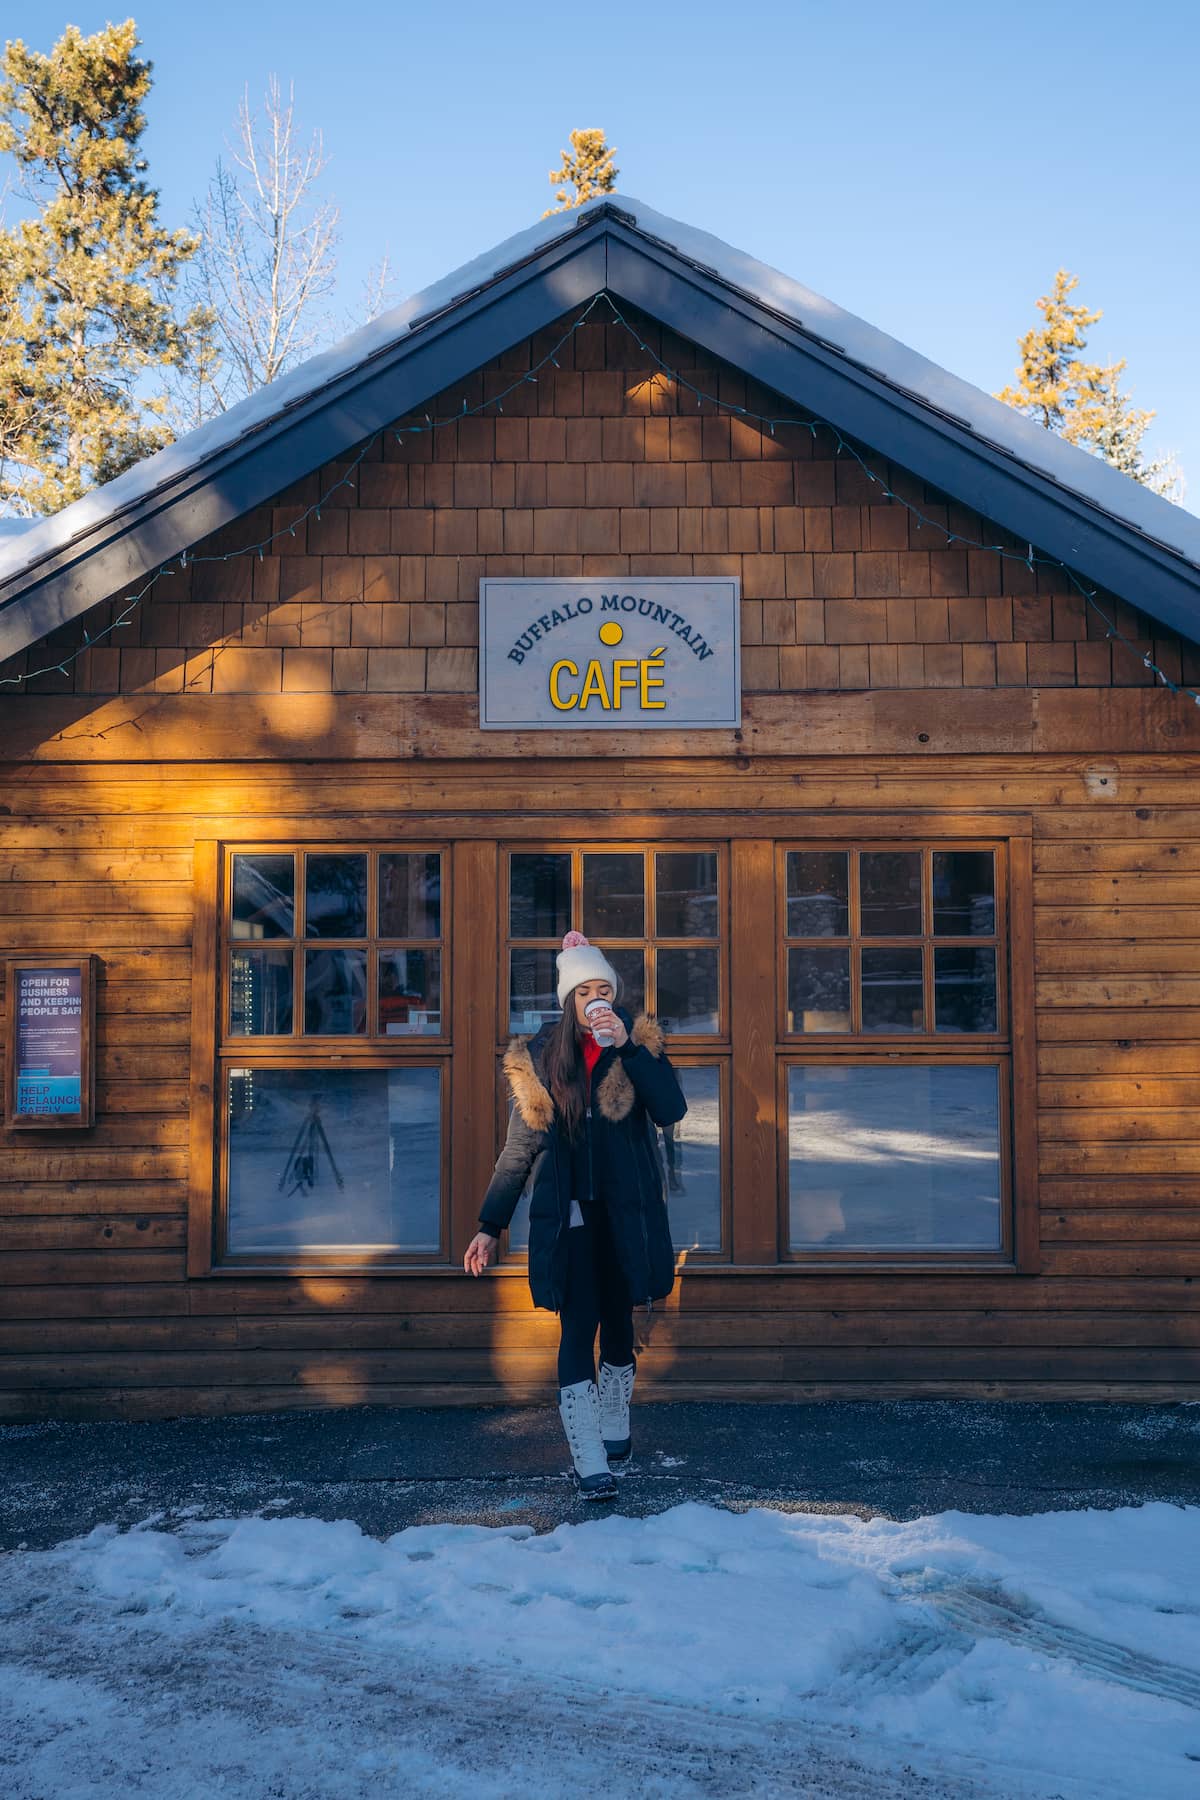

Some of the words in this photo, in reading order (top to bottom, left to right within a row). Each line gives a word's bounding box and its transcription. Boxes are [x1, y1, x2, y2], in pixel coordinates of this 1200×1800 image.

[507, 597, 593, 666] BUFFALO
[600, 594, 714, 661] MOUNTAIN
[548, 647, 667, 710] CAFÉ
[21, 978, 48, 987] OPEN
[50, 978, 70, 986] FOR
[21, 988, 68, 997] BUSINESS
[21, 998, 41, 1006] AND
[44, 997, 81, 1006] KEEPIN
[21, 1007, 59, 1016] PEOPLE
[21, 1086, 50, 1095] HELP
[20, 1096, 81, 1105] RELAUNCH
